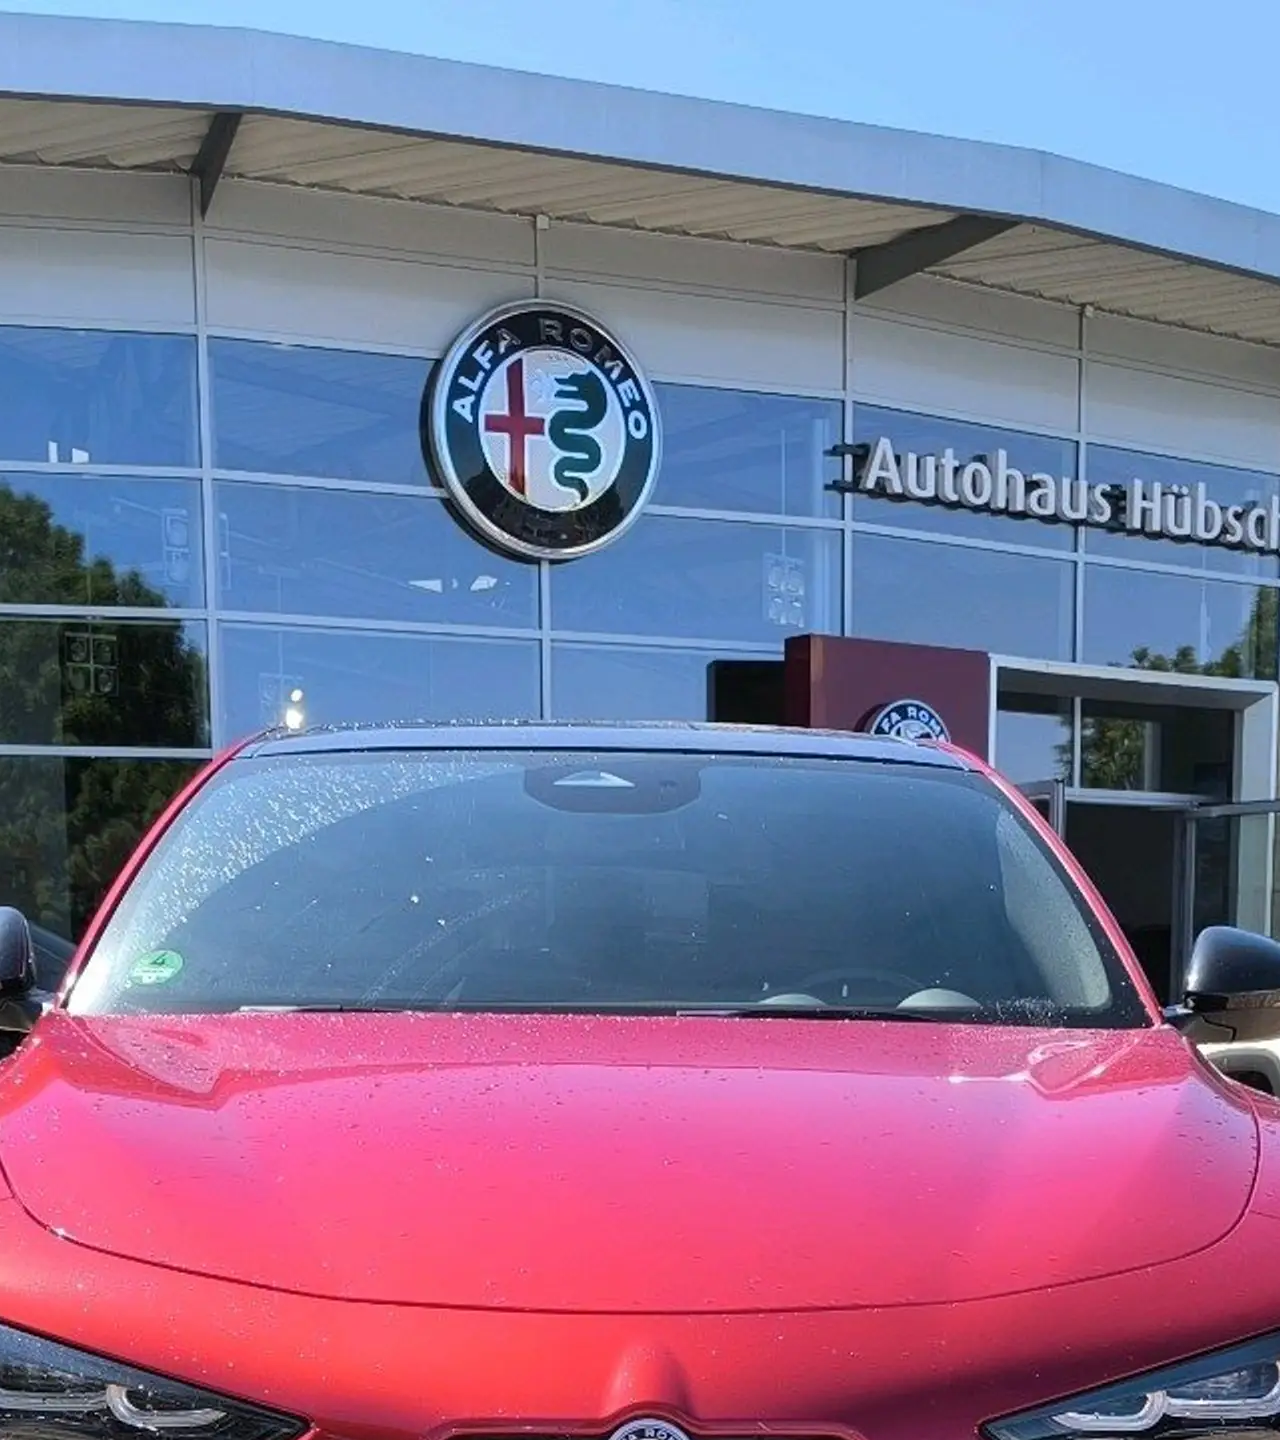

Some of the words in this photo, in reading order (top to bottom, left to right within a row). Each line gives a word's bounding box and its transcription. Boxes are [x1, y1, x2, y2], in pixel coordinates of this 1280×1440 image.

[452, 328, 521, 423] ALFA
[539, 318, 647, 440] ROMEO
[864, 436, 1112, 524] Autohaus
